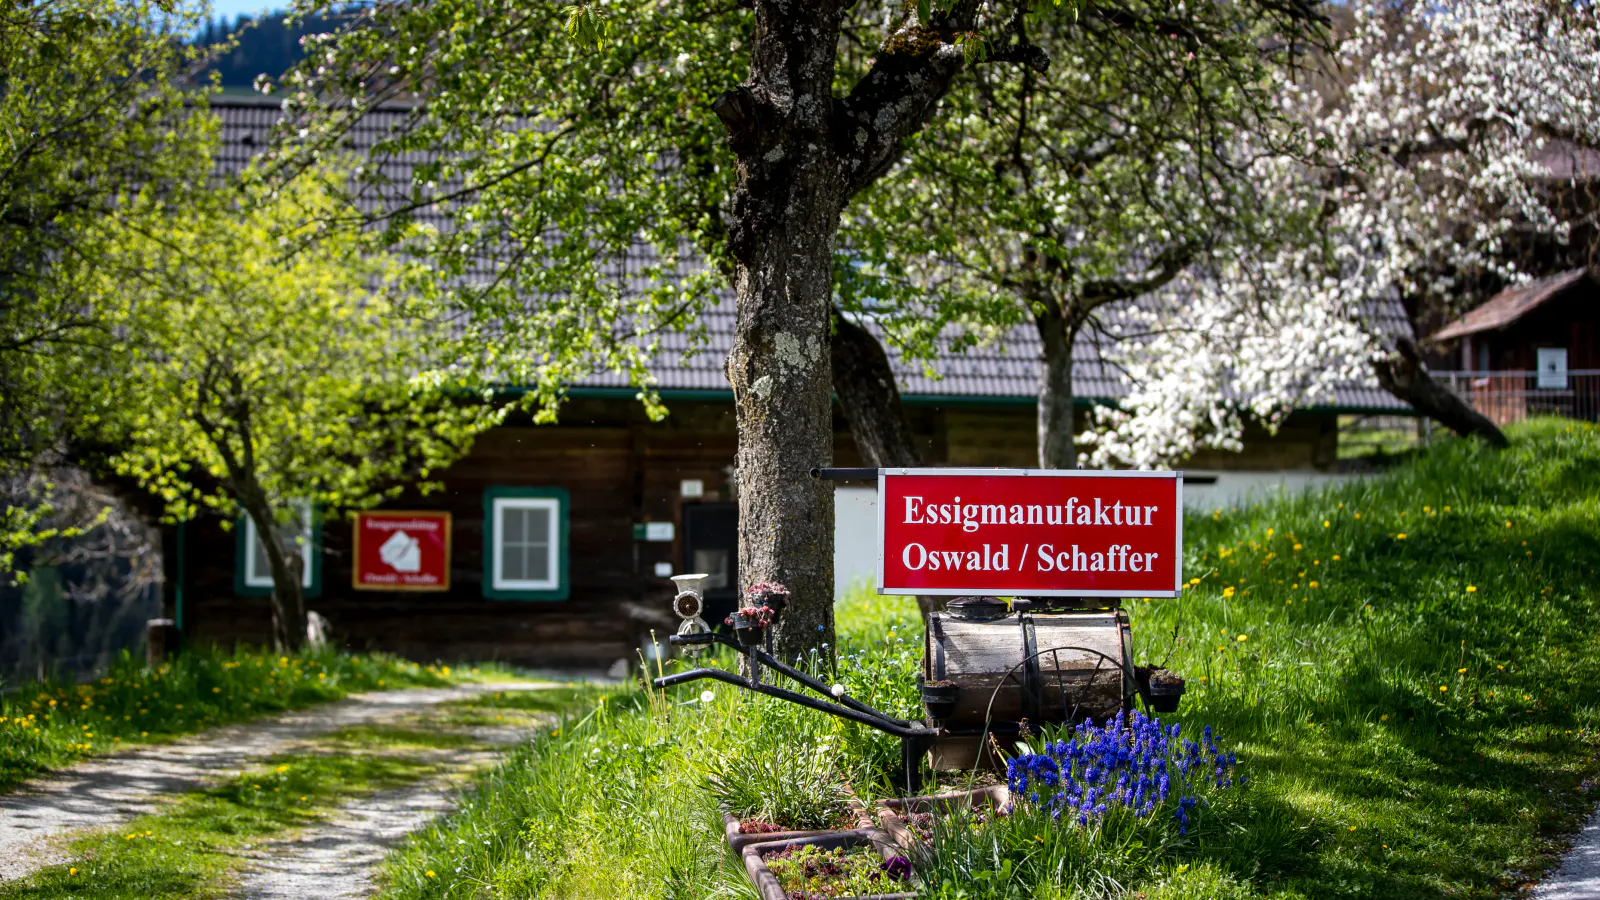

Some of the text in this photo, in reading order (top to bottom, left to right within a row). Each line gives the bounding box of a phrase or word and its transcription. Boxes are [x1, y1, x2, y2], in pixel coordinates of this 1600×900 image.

[903, 496, 1158, 532] Essigmanufaktur
[902, 543, 1158, 572] Oswald / Schaffer
